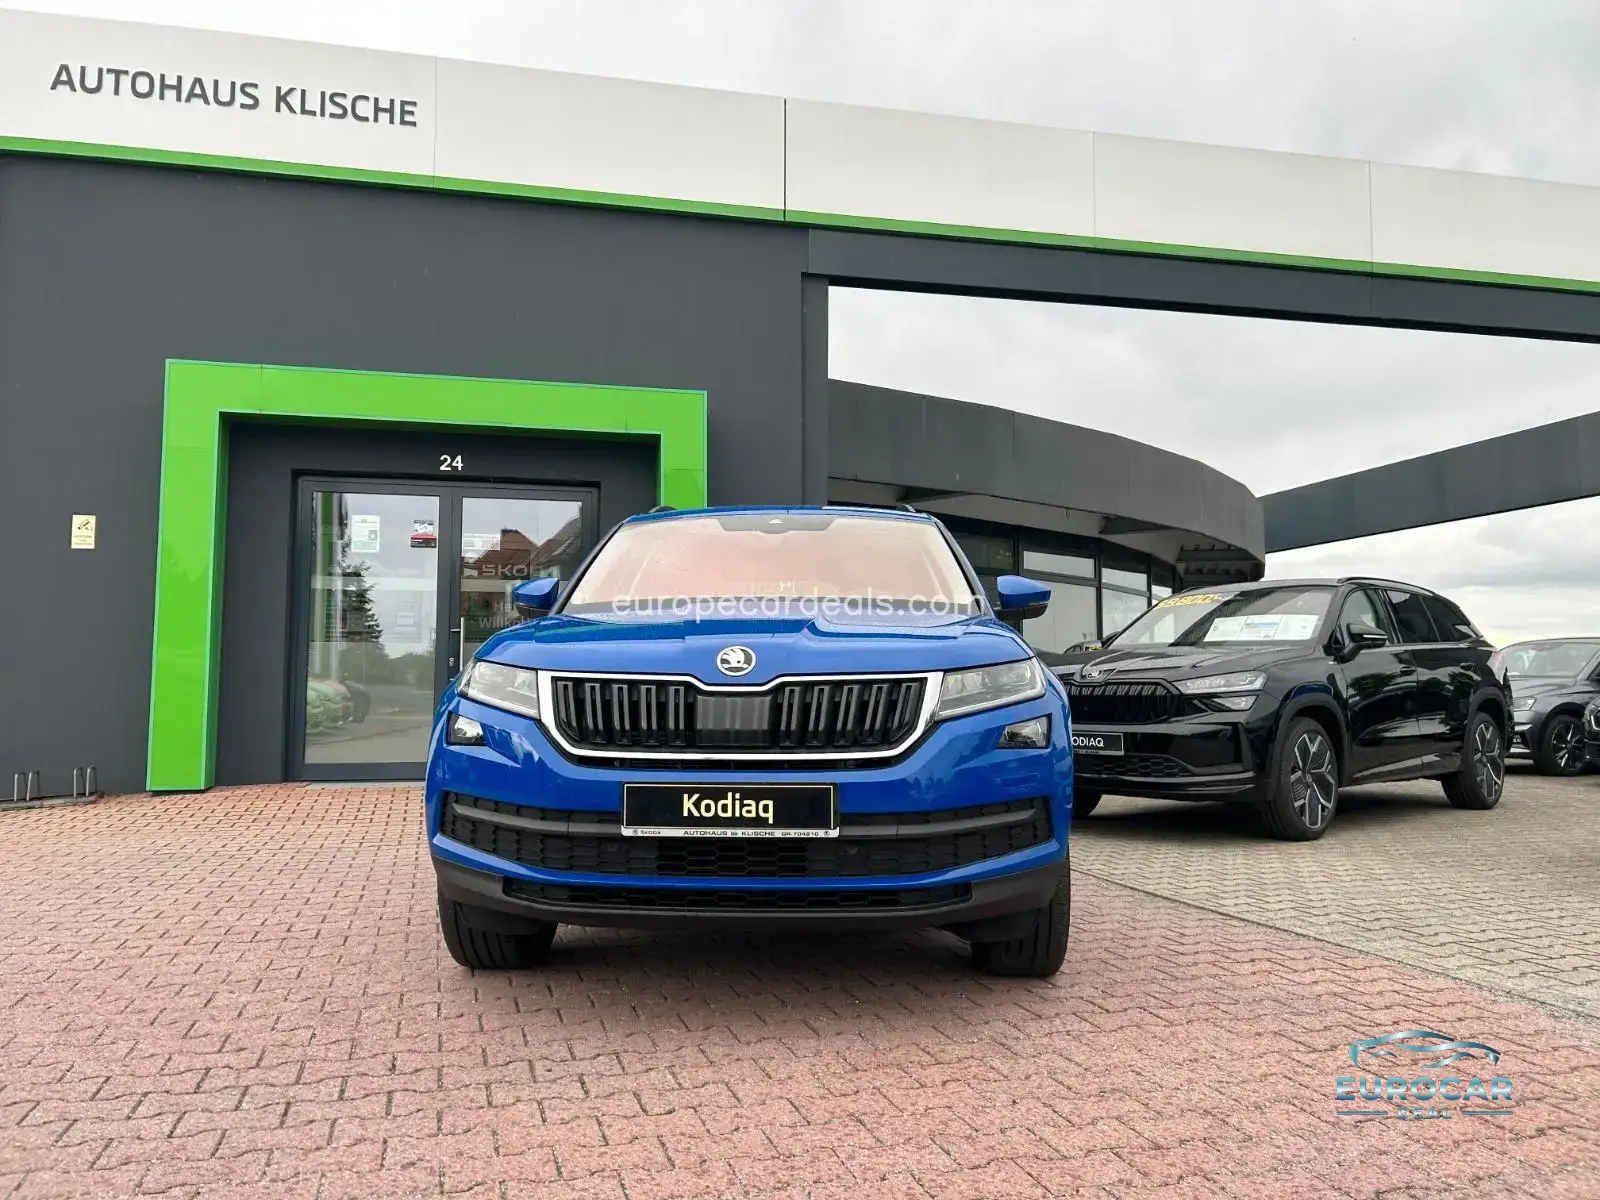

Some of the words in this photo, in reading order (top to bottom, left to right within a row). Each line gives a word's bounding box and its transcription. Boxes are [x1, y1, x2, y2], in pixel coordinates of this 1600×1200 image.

[50, 63, 260, 110] AUTOHAUS
[274, 86, 418, 127] KLISCHE
[439, 454, 464, 471] 24
[1072, 736, 1105, 748] ODIAQ
[682, 791, 774, 825] Kodiaq
